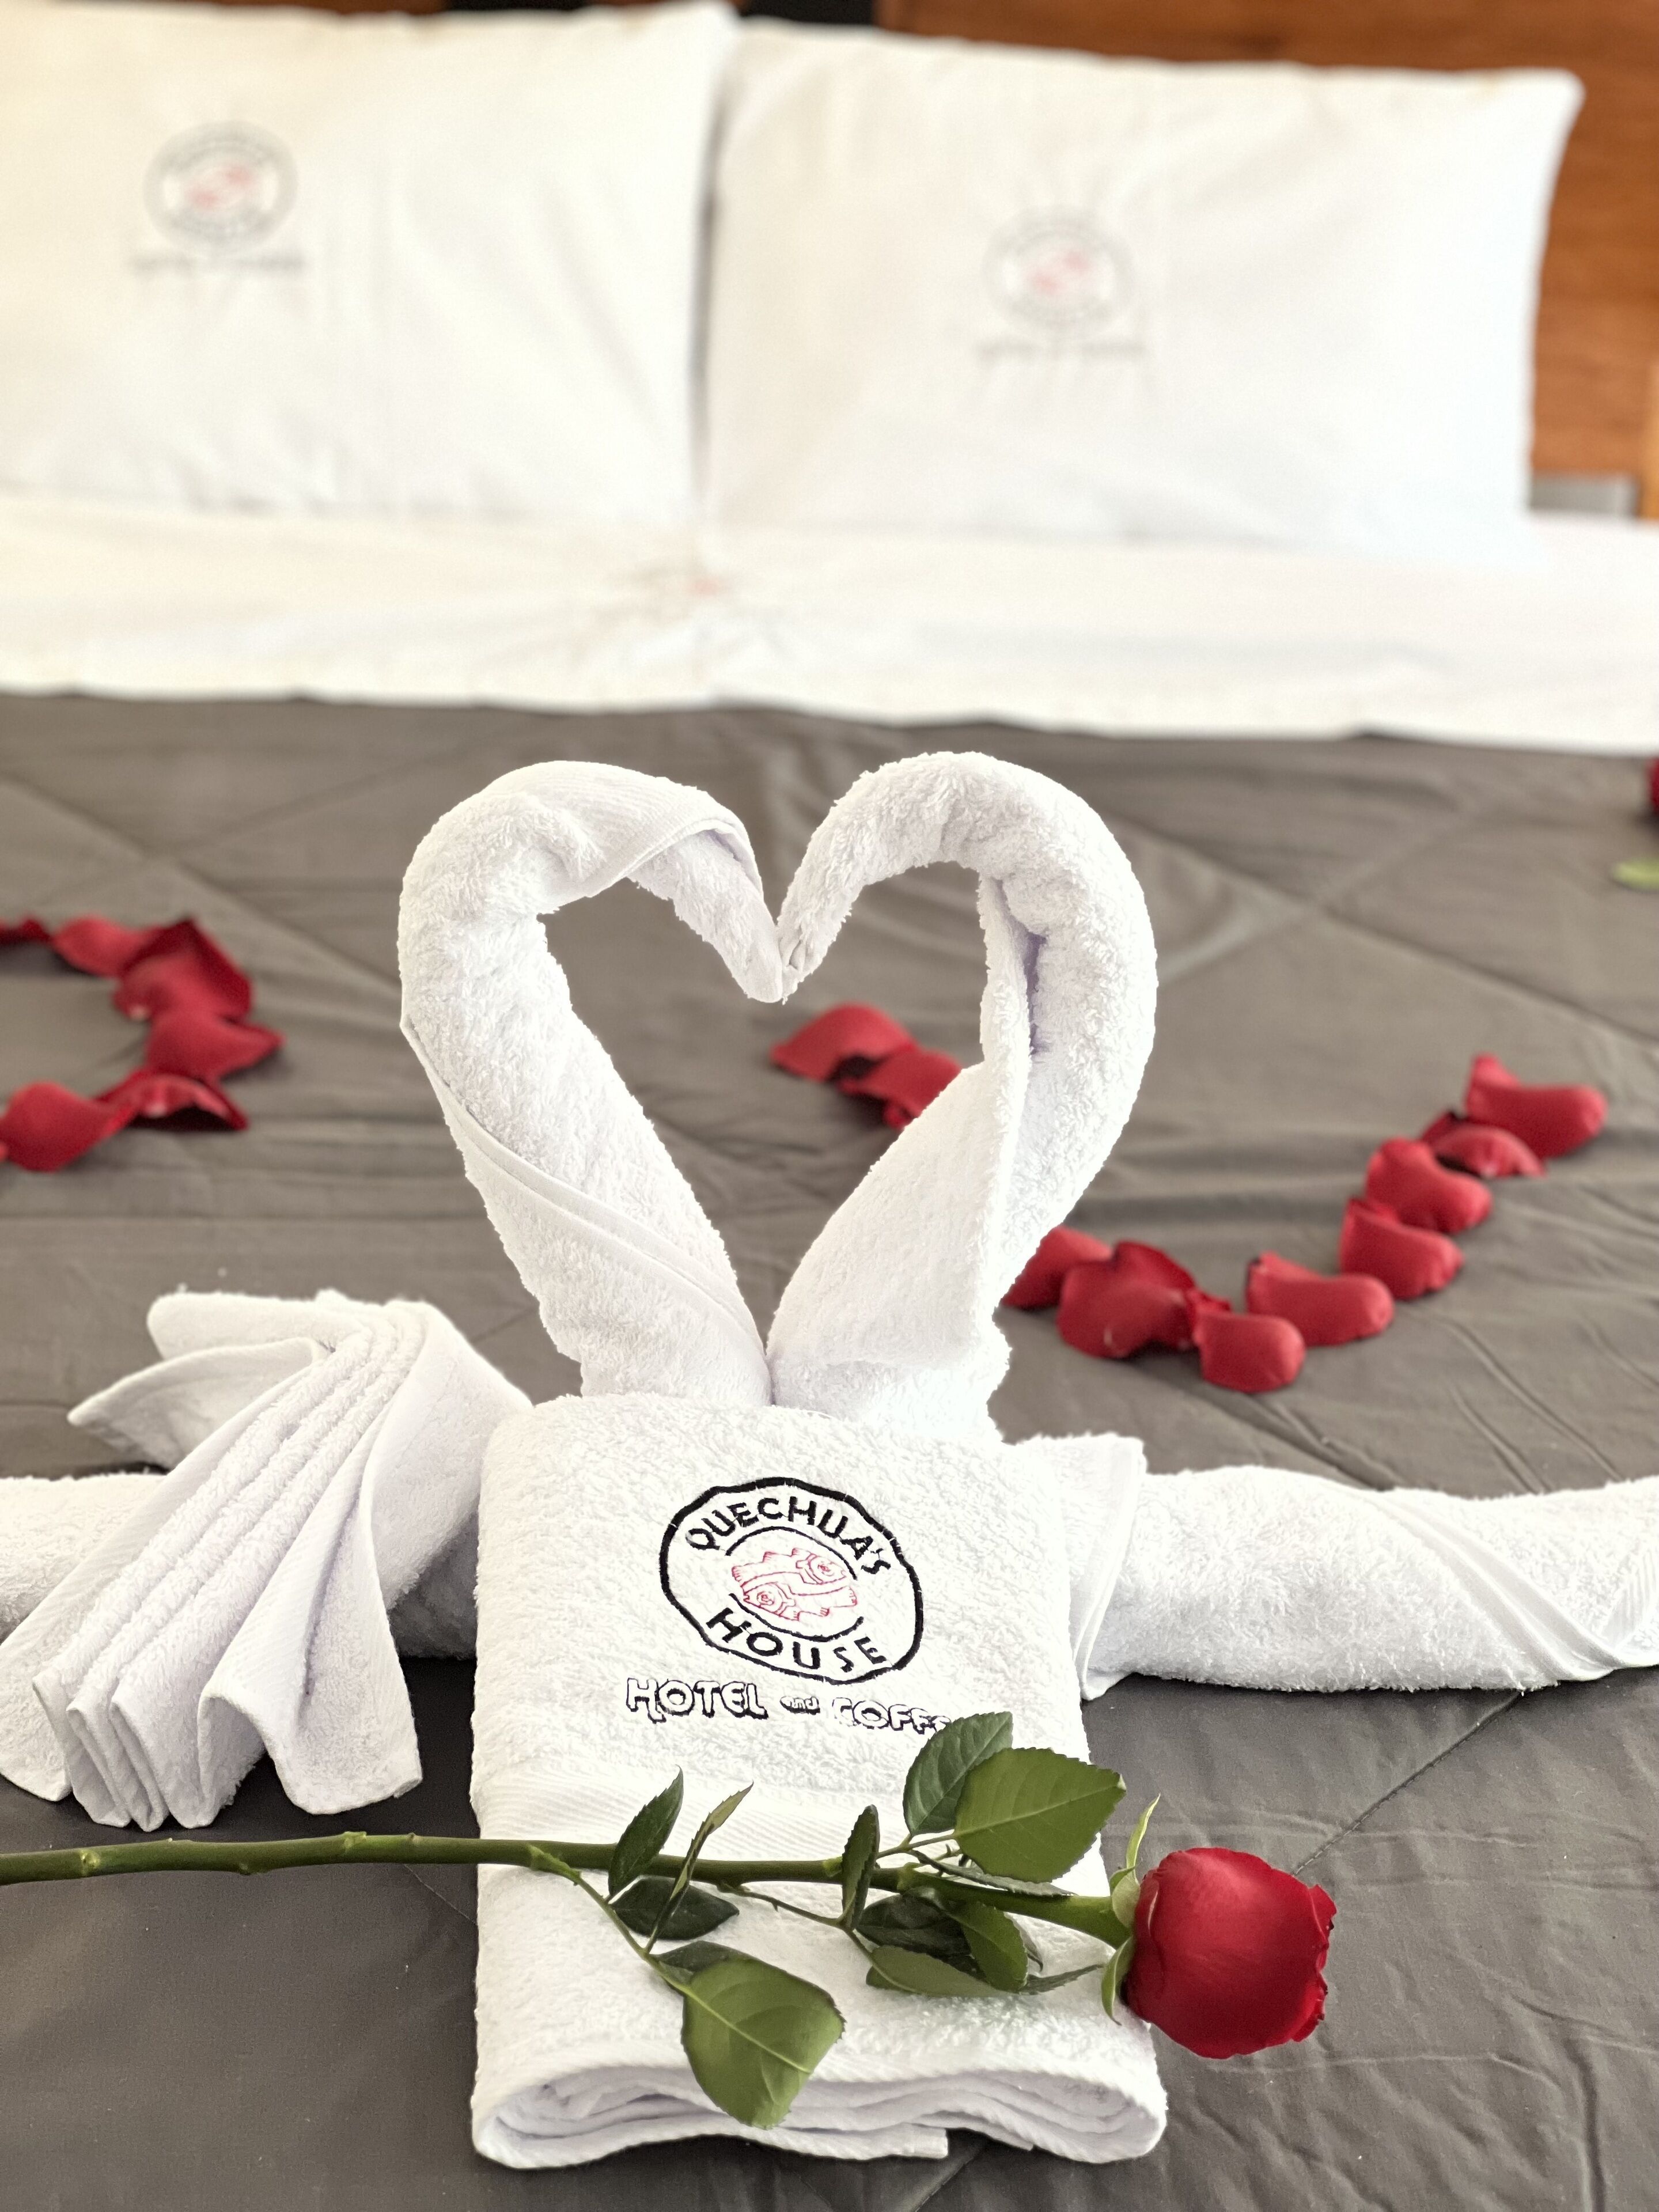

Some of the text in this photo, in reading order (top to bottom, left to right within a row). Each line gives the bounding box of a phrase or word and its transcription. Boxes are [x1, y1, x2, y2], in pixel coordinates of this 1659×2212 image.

[685, 1497, 891, 1575] QUECHUA'S
[707, 1608, 888, 1672] HOUSE
[626, 1678, 768, 1724] HOTEL
